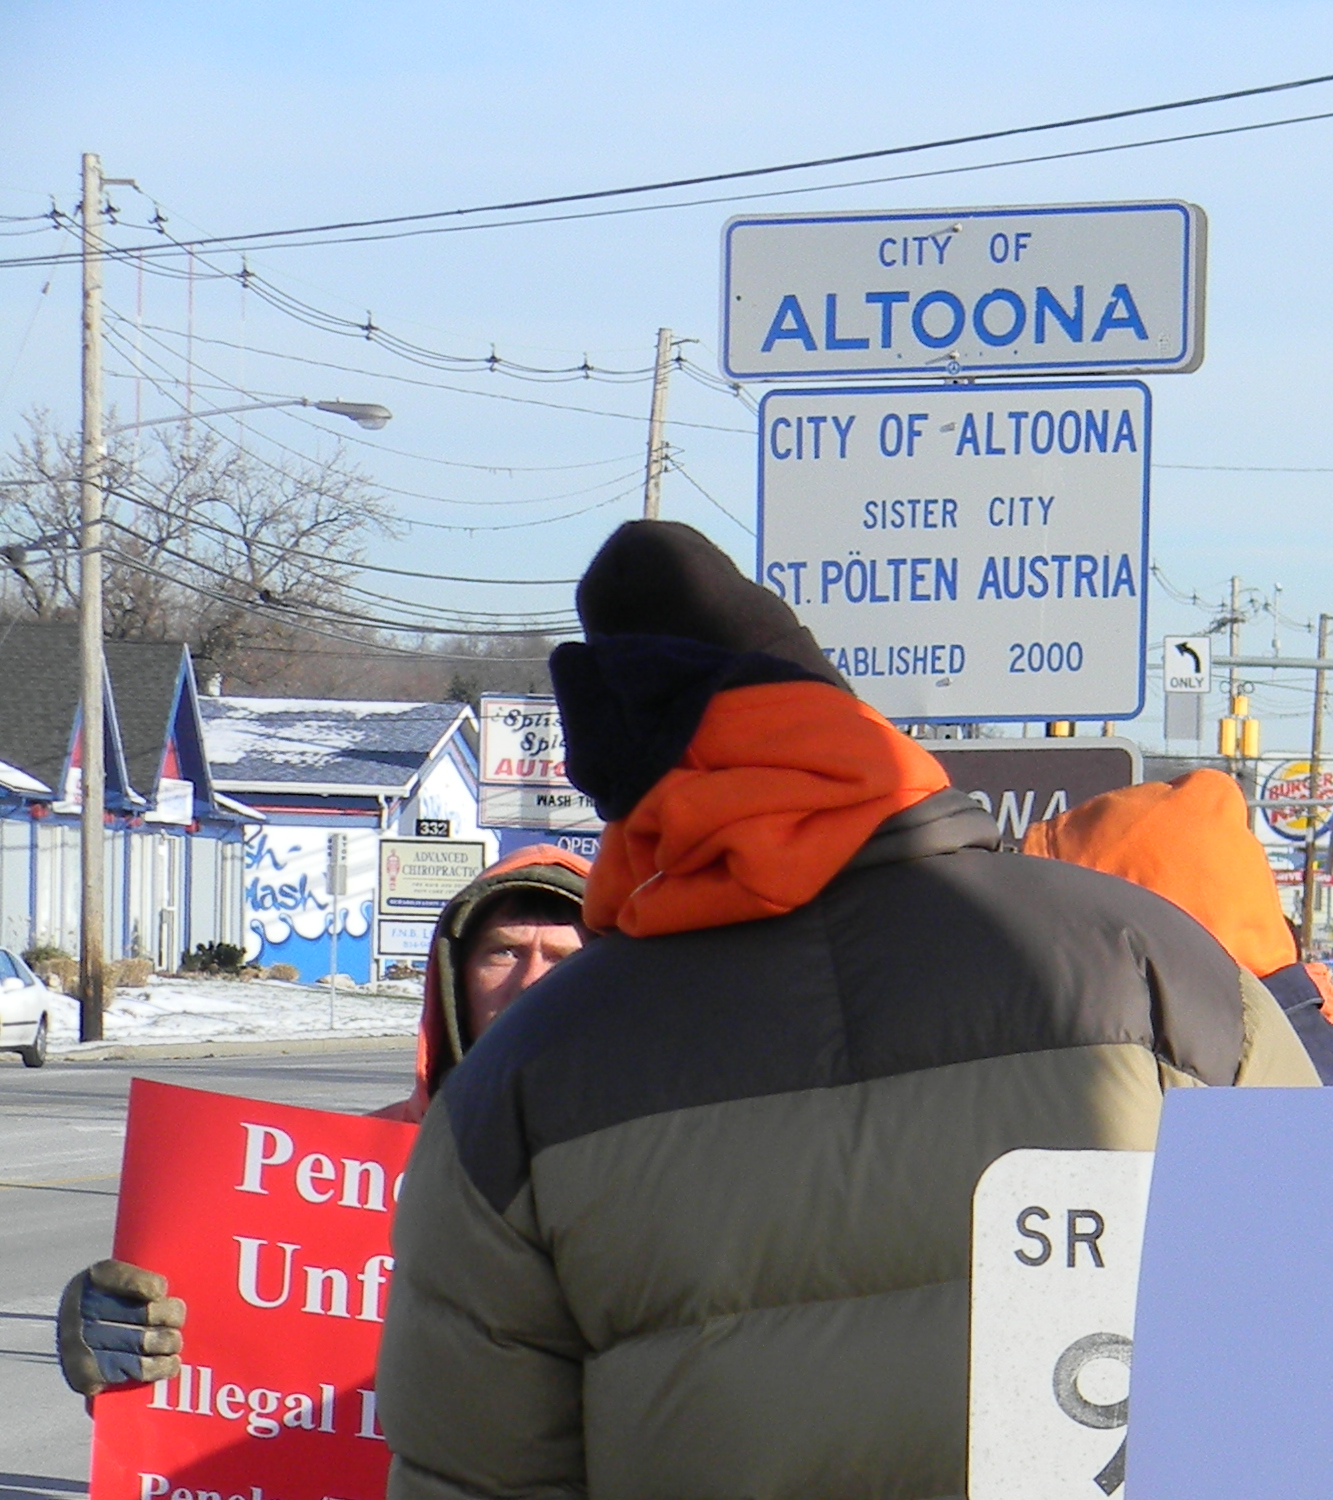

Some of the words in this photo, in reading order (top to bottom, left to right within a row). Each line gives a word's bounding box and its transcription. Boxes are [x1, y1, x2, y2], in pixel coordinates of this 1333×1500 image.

[879, 236, 952, 267] CITY
[989, 232, 1032, 263] OF
[761, 283, 1149, 353] ALTOONA
[770, 415, 856, 459] CITY
[879, 413, 929, 457] OF
[956, 409, 1138, 456] ALTOONA
[863, 498, 958, 530] SISTER
[988, 496, 1055, 527] CITY
[820, 551, 958, 604] PÖLTEN
[977, 554, 1137, 600] AUSTRIA
[1009, 641, 1084, 674] 2000
[1170, 677, 1204, 688] ONLY
[537, 794, 571, 807] WASH
[419, 822, 448, 835] 332
[413, 852, 468, 864] ADVANCED
[1014, 1206, 1106, 1268] SR
[232, 1235, 397, 1323] Unf
[147, 1364, 336, 1439] Illegal
